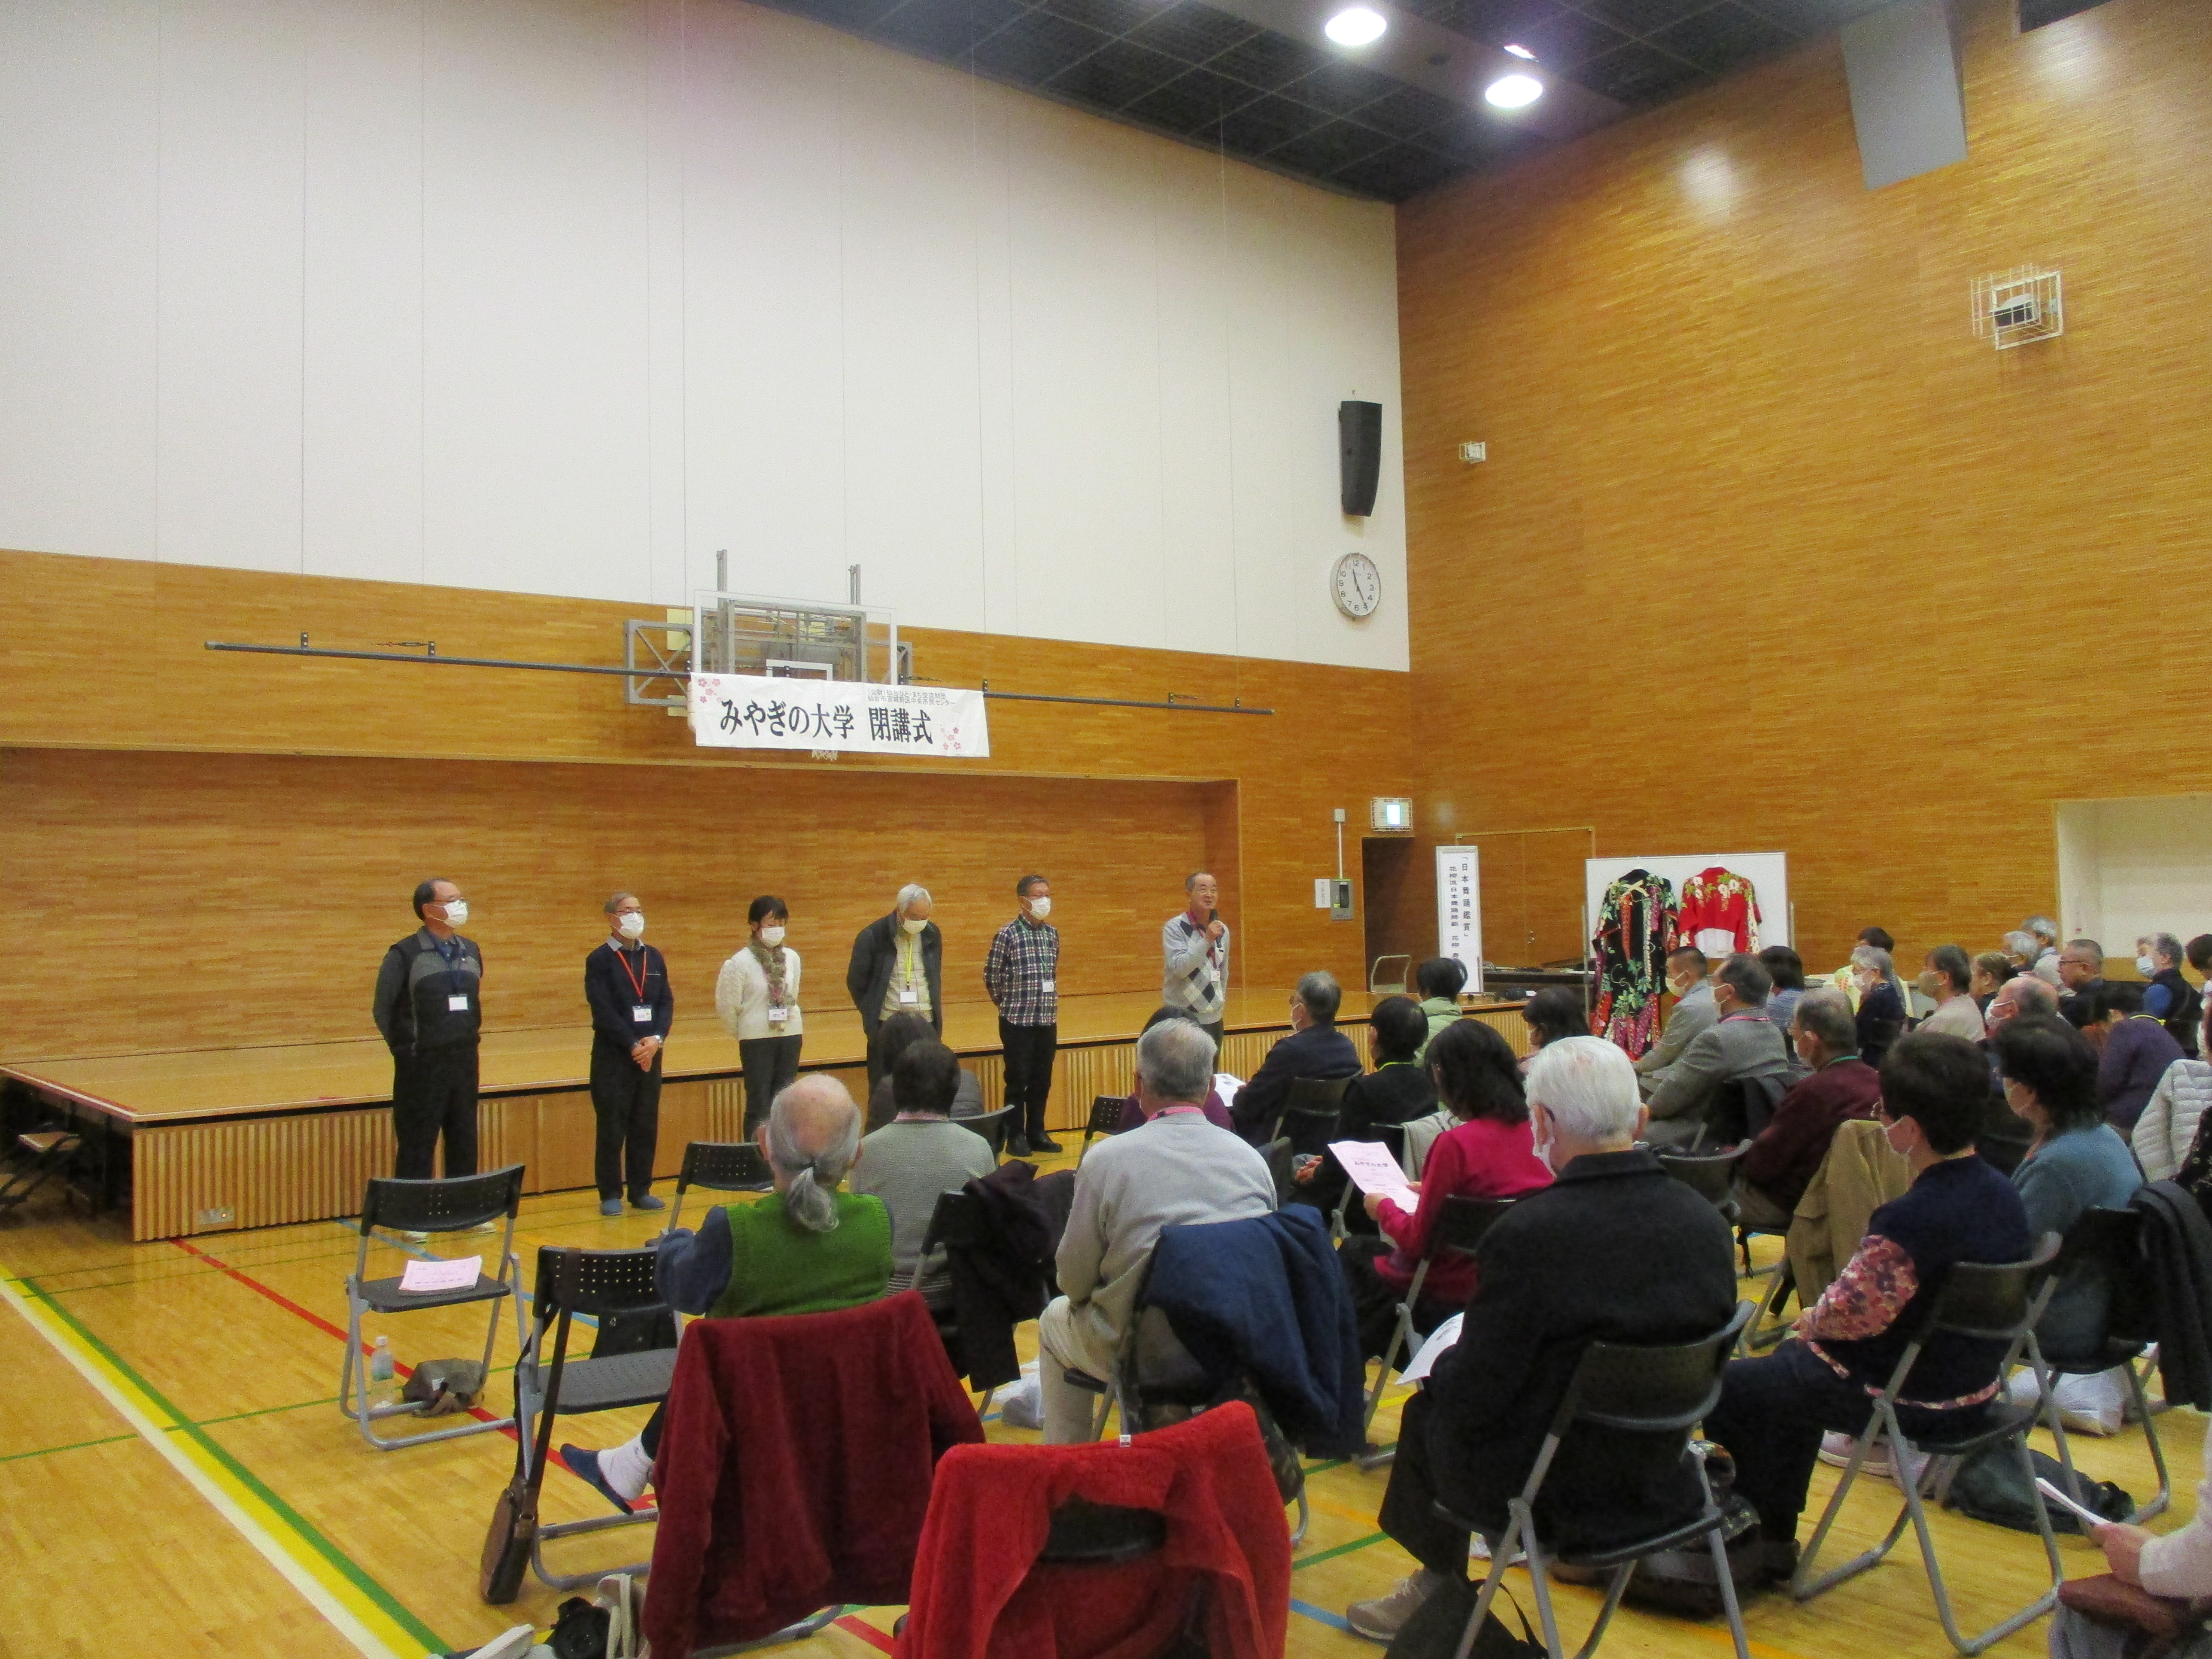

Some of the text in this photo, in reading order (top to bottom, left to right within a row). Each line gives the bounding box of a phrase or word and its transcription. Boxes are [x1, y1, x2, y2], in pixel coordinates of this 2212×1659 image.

[720, 699, 933, 744] みやぎの大学 閉講式
